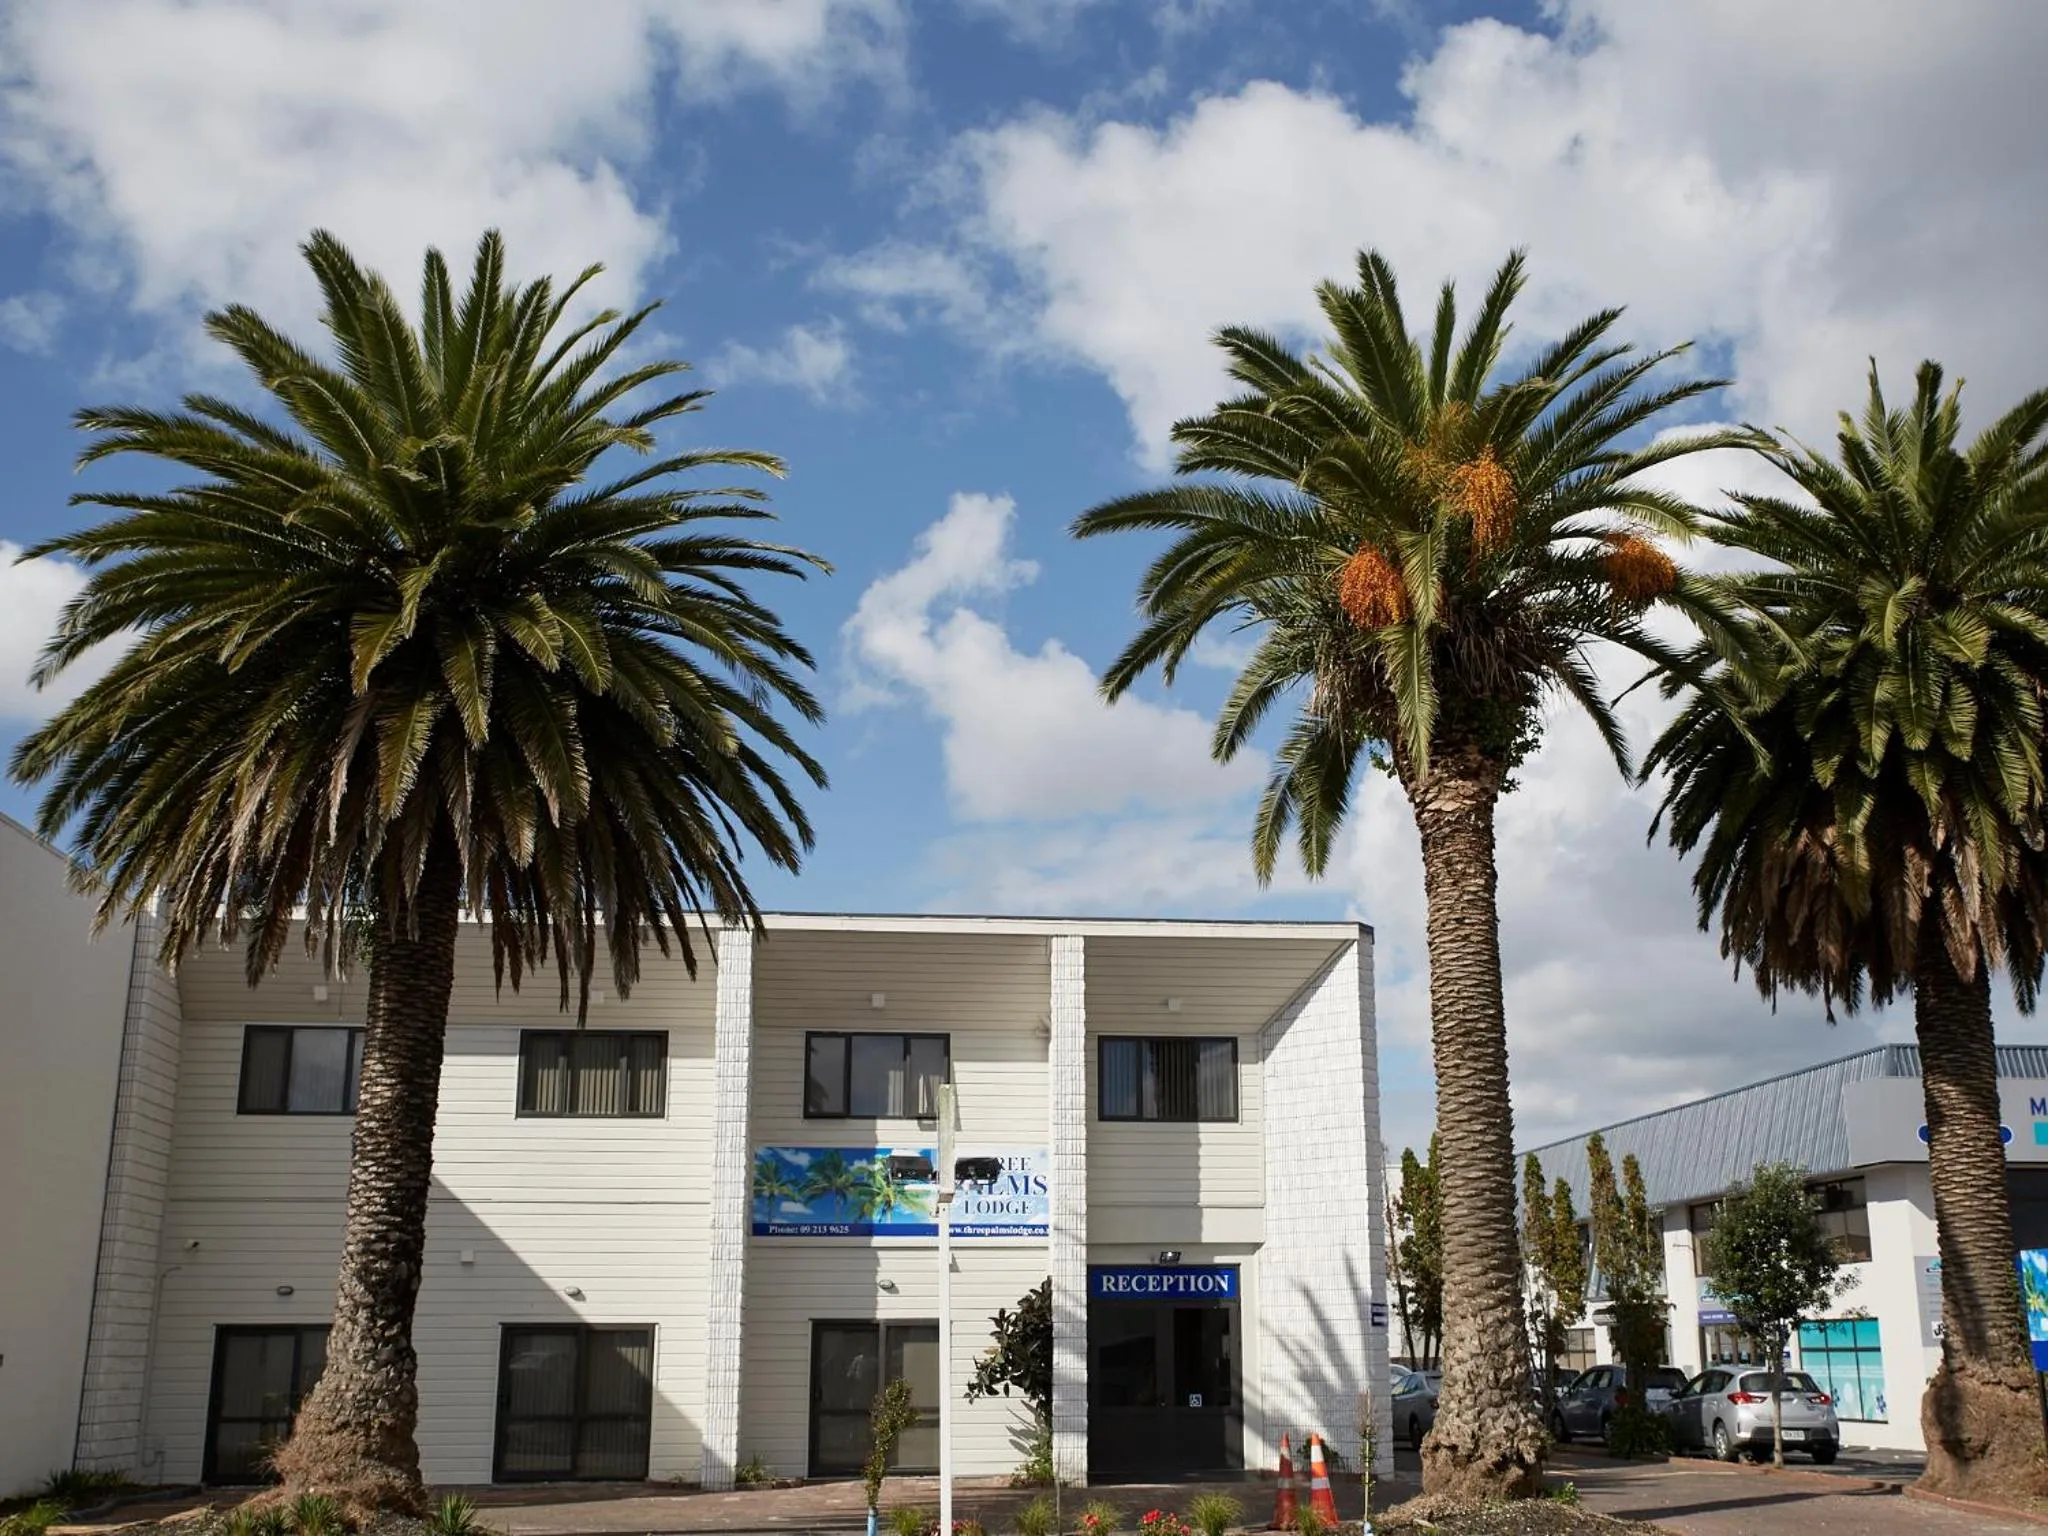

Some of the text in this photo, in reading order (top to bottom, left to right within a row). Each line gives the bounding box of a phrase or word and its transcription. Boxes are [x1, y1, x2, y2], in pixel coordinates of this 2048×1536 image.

[965, 1200, 1032, 1215] LODGE
[769, 1225, 849, 1234] Phone: 09 213 9625
[1101, 1274, 1229, 1293] RECEPTION
